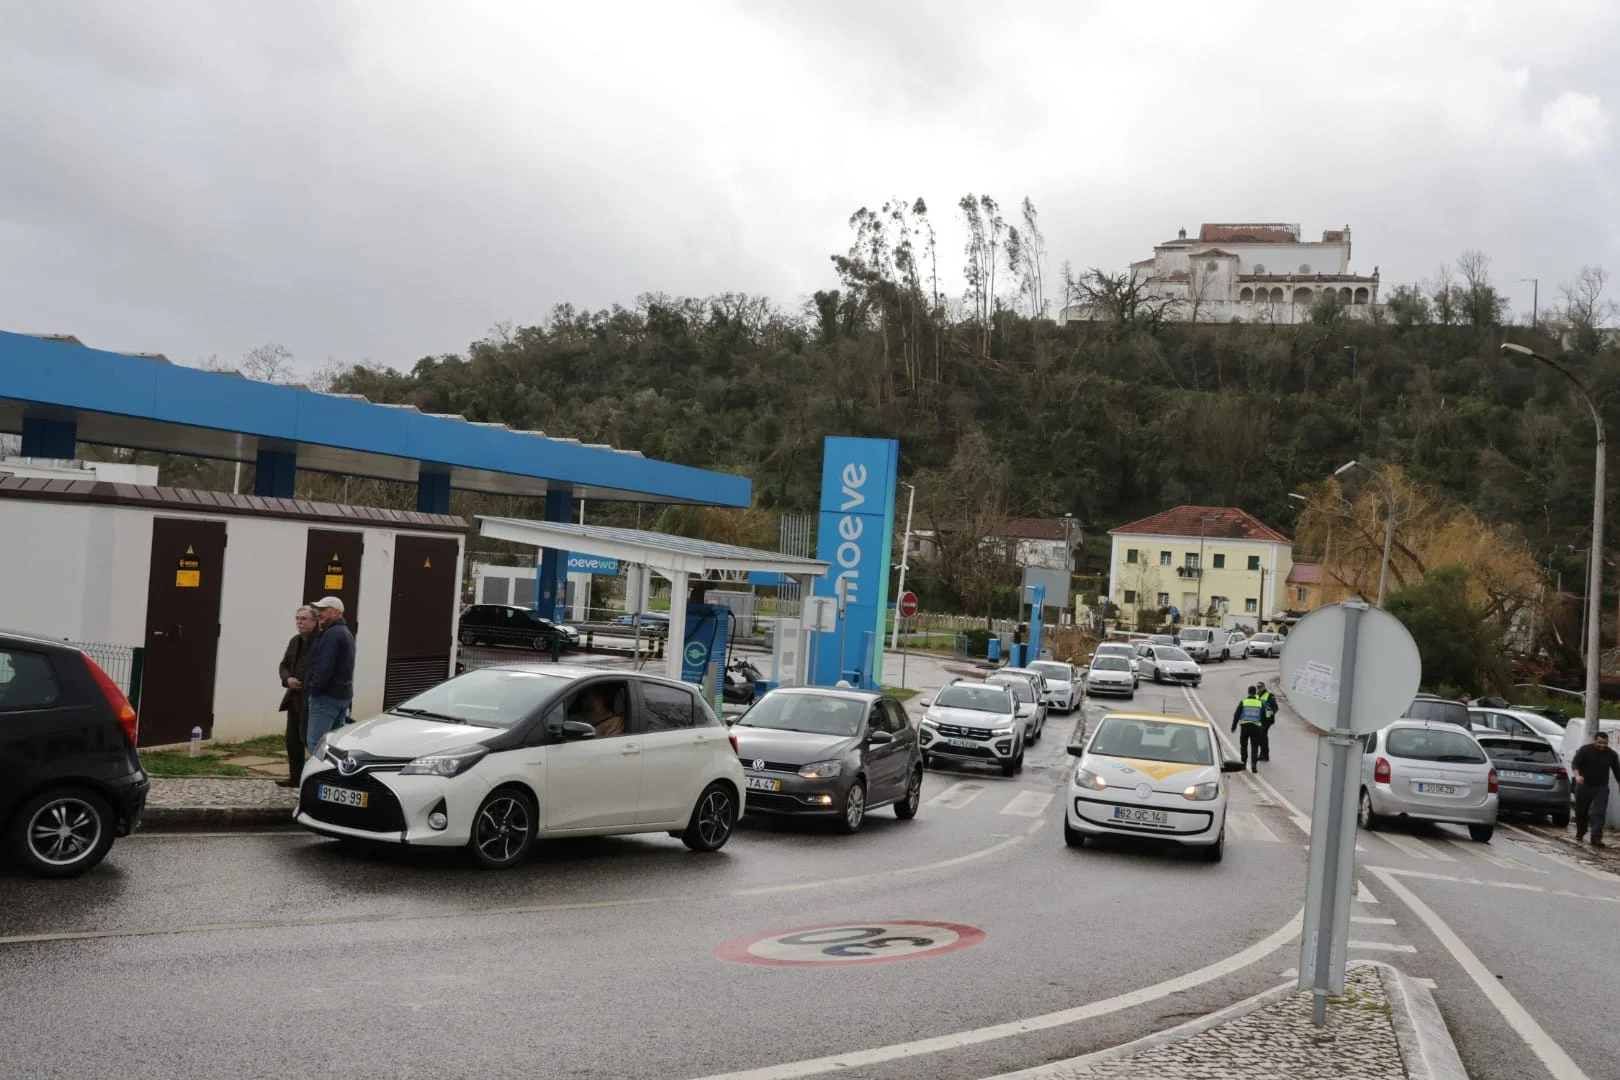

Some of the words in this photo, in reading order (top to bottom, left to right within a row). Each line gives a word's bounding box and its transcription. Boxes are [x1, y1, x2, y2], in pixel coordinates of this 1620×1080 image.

[834, 463, 867, 603] moeve
[567, 558, 618, 569] oevewa
[777, 926, 935, 957] 30
